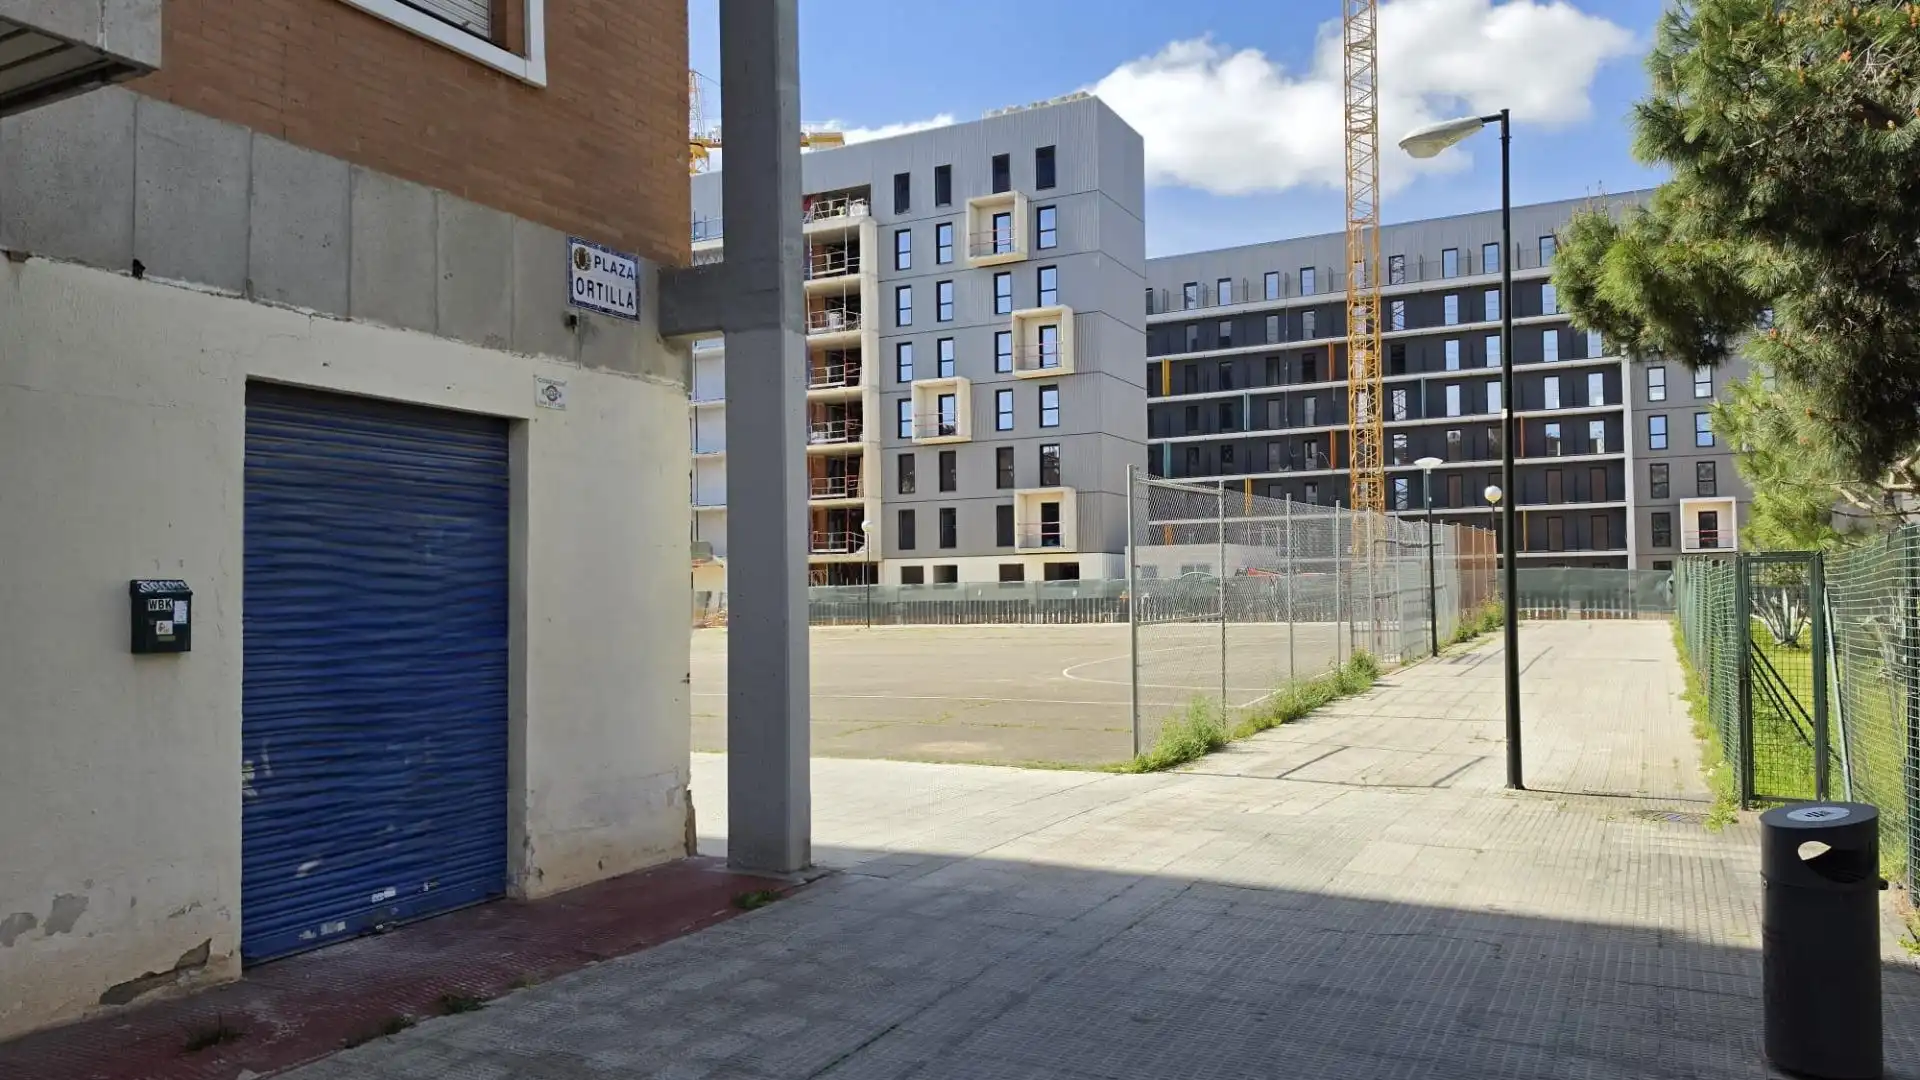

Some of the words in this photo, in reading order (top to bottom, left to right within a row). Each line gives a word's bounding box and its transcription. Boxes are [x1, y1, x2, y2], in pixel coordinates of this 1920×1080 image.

[594, 255, 634, 281] PLAZA
[576, 277, 634, 310] ORTILLA
[149, 599, 172, 610] WBK
